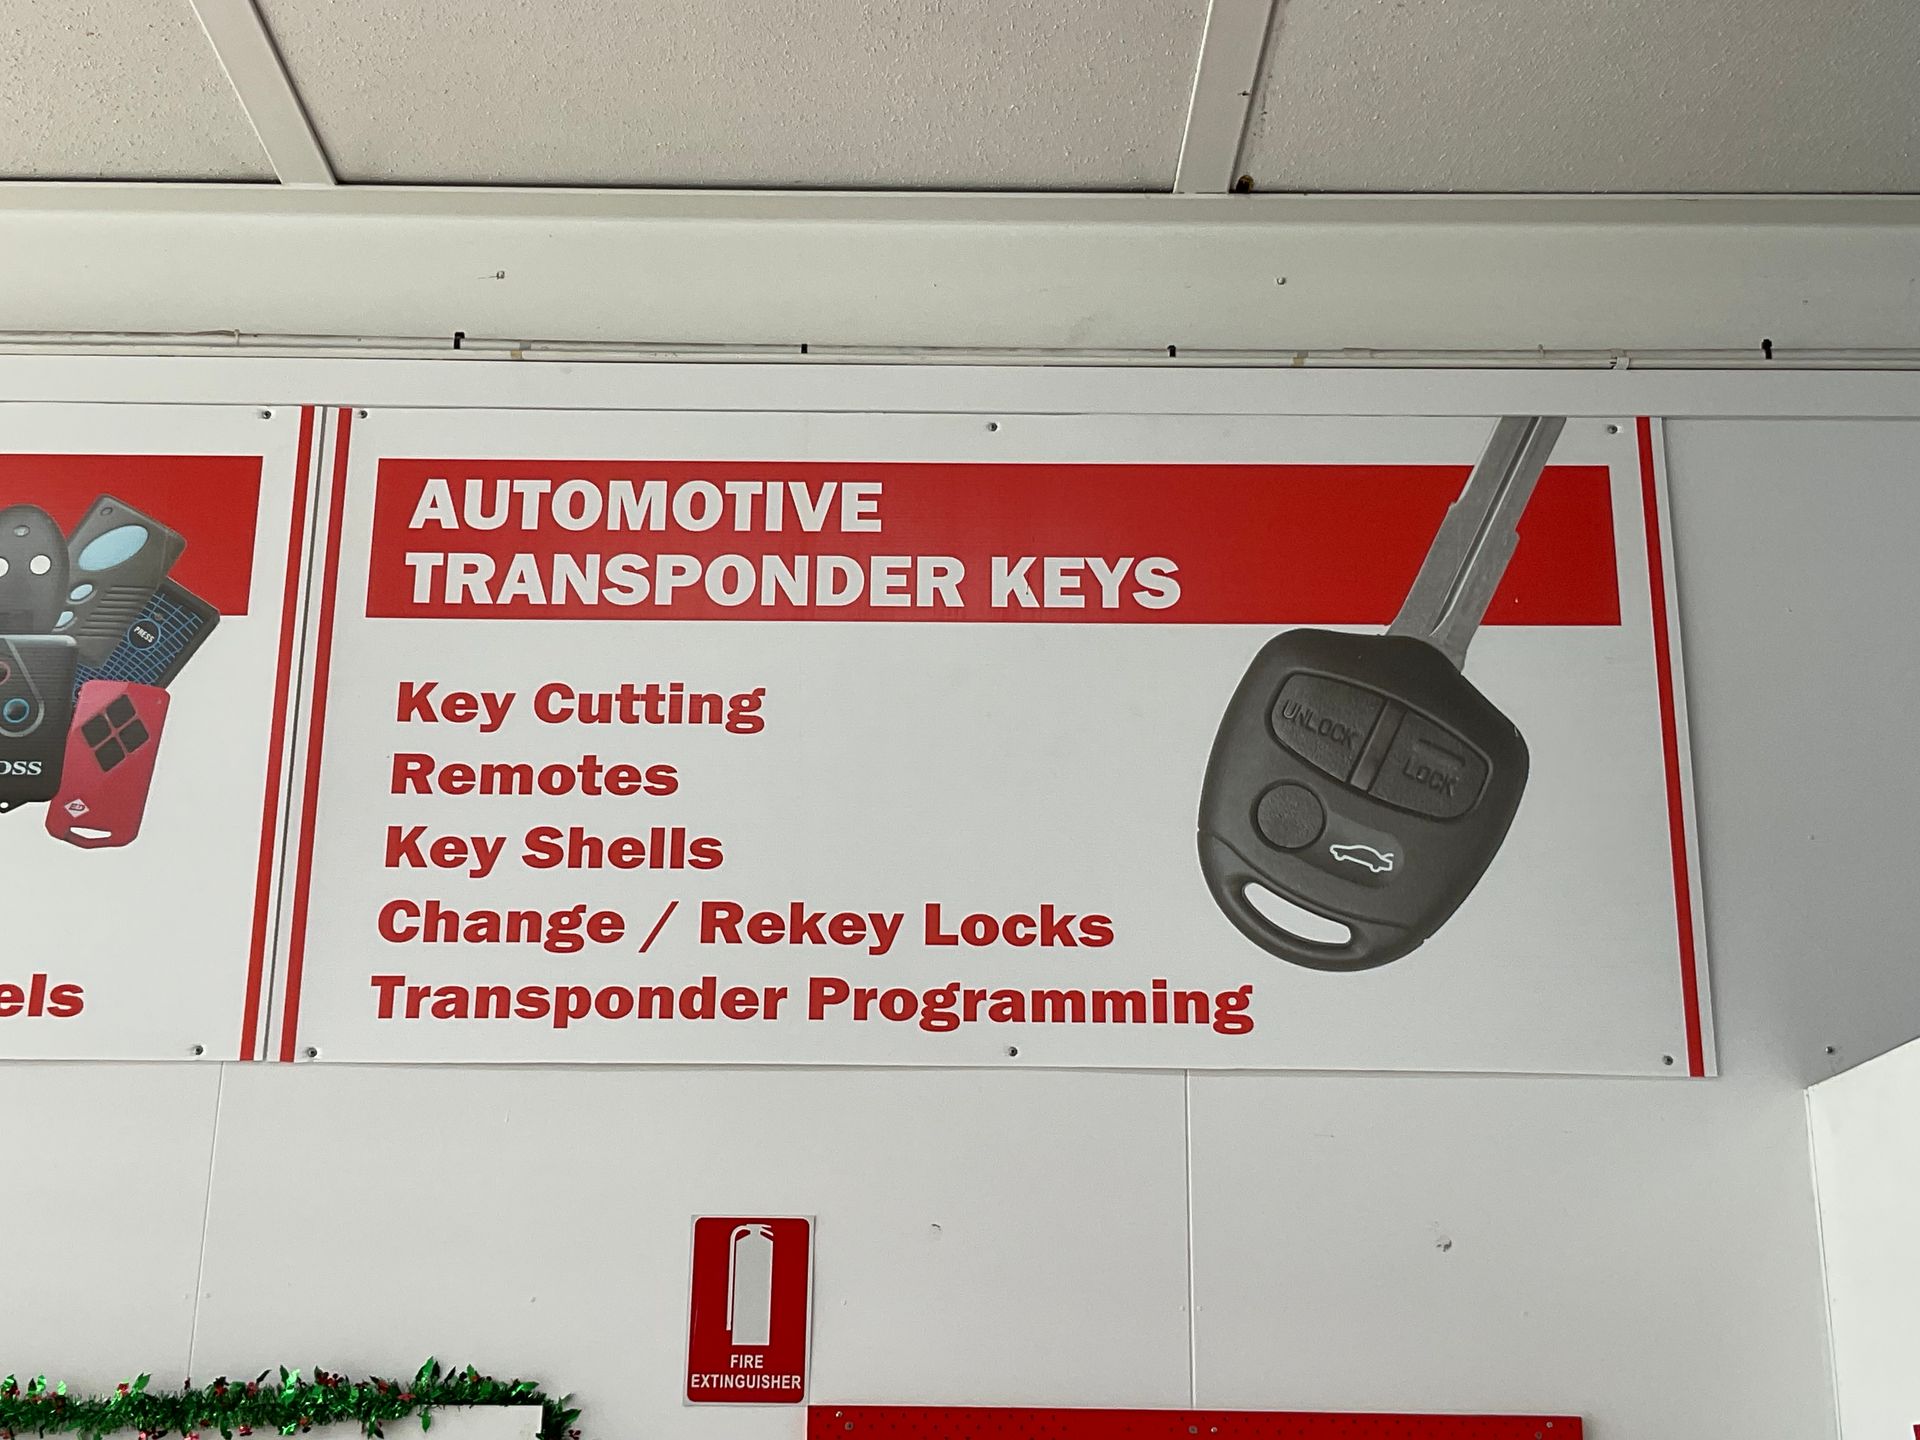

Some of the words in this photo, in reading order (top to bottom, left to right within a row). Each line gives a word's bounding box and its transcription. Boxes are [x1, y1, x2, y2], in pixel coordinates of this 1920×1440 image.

[408, 478, 883, 534] AUTOMOTIVE
[405, 551, 966, 609] TRANSPONDER
[990, 556, 1182, 611] KEYS
[397, 681, 515, 733] Key
[533, 682, 766, 734] Cutting
[1282, 699, 1357, 748] UNLOCK
[391, 752, 679, 797] Remotes
[1402, 754, 1459, 798] LOCK
[384, 825, 506, 879] Key
[522, 825, 724, 871] Shells
[377, 899, 626, 954] Change
[639, 901, 677, 953] /
[699, 900, 904, 956] Rekey
[924, 903, 1114, 949] Locks
[0, 973, 84, 1018] els
[371, 975, 789, 1029] Transponder
[808, 976, 1255, 1035] Programming
[691, 1373, 801, 1390] EXTINGUISHER
[730, 1354, 764, 1369] FIRE
